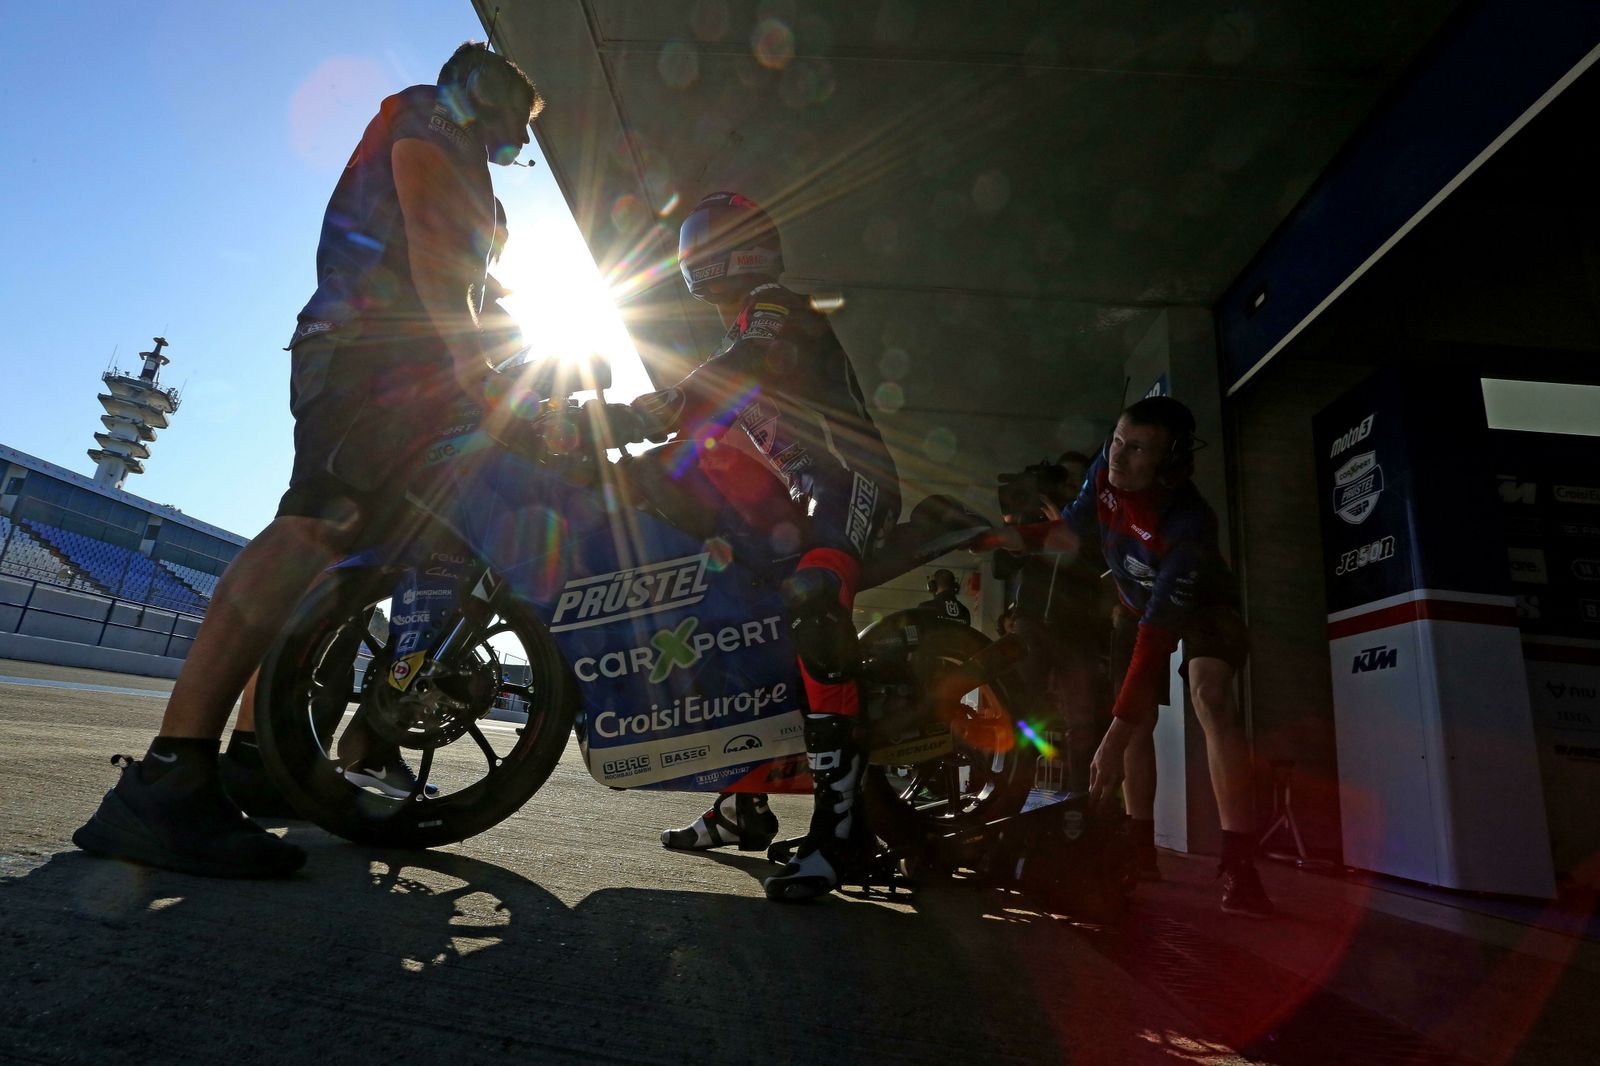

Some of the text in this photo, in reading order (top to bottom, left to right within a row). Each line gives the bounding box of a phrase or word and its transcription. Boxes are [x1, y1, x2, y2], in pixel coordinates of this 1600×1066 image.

[1330, 414, 1375, 459] moto3
[552, 561, 710, 624] PRÜSTEL
[1352, 646, 1397, 674] KTM
[595, 682, 787, 738] CroisiEurope
[664, 749, 708, 765] BASEG
